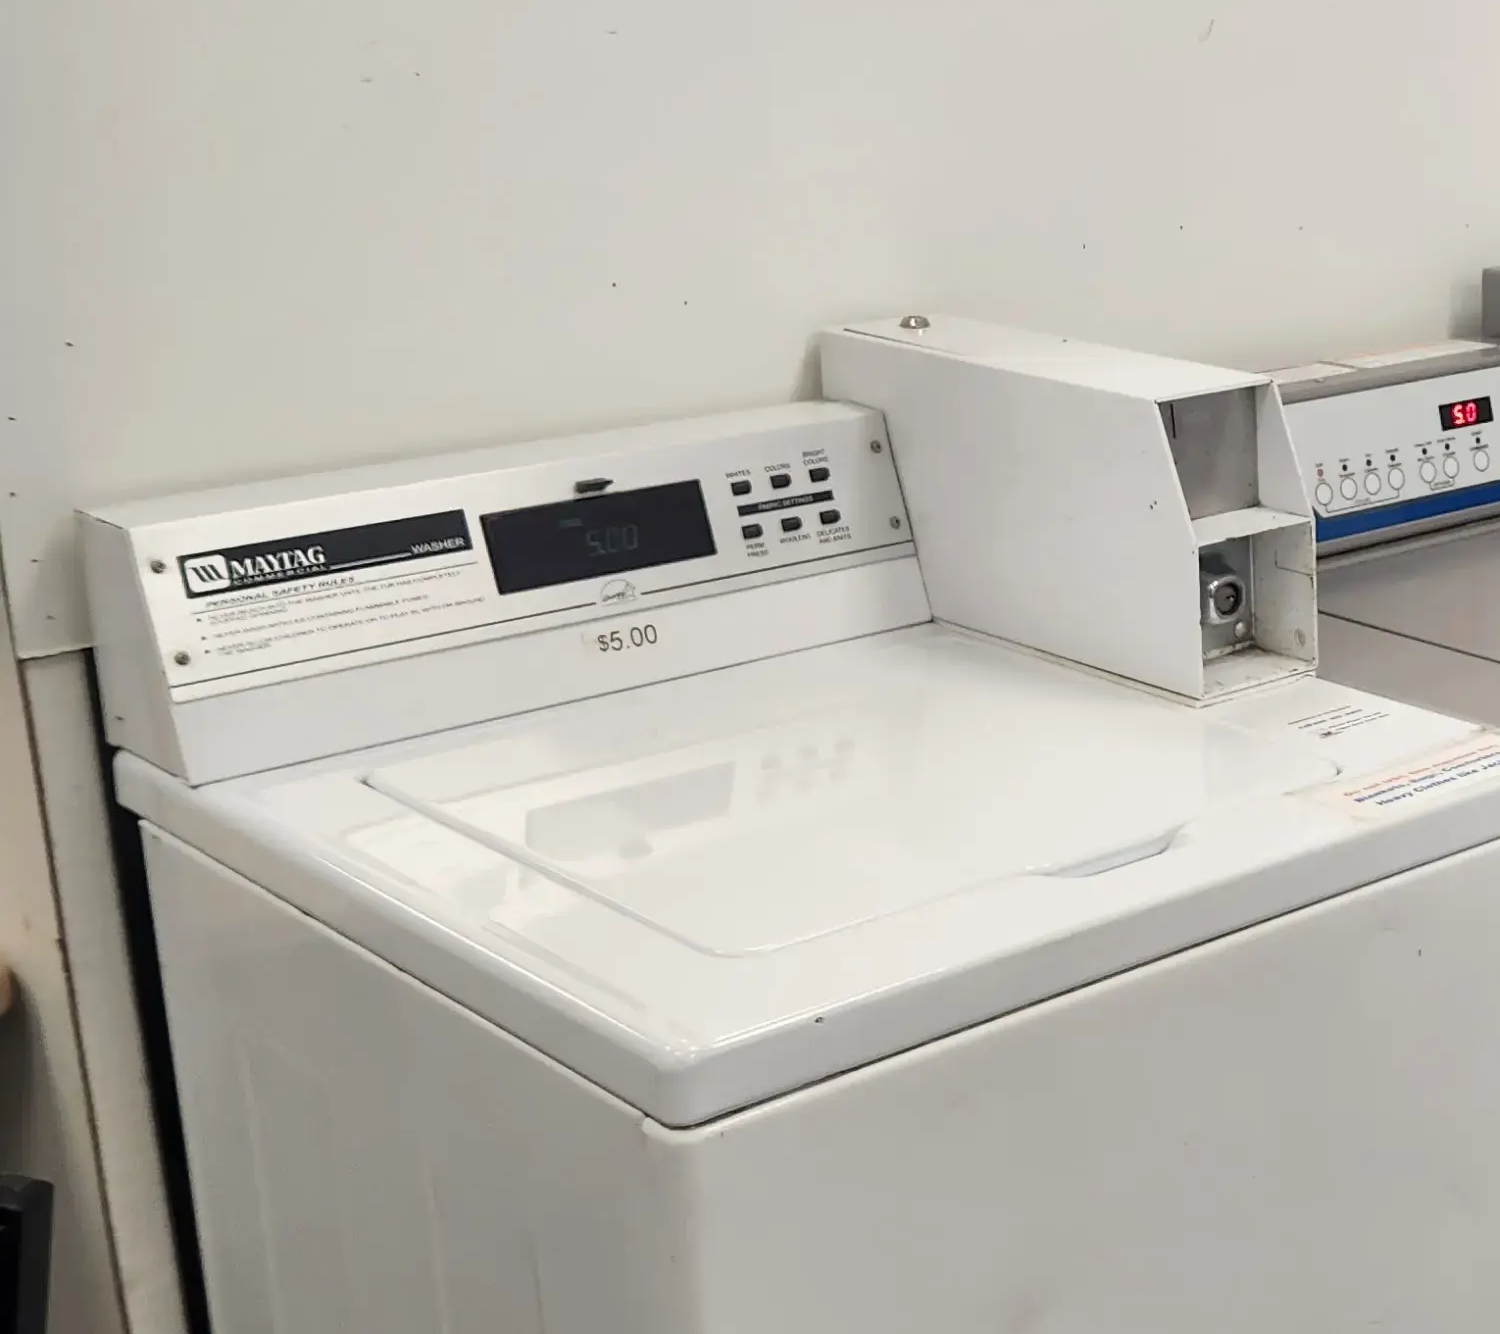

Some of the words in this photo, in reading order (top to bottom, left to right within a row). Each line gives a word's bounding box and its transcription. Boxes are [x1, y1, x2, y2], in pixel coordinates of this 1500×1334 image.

[764, 463, 790, 473] COLORS
[803, 456, 829, 466] COLORS
[725, 470, 751, 478] WHITES
[782, 495, 814, 506] SETTINGS
[411, 537, 465, 554] WASHER
[229, 545, 326, 579] MAYTAG
[232, 565, 328, 585] COMMERCIAL
[205, 591, 267, 607] PERSONAL
[272, 583, 315, 596] SAFETY
[318, 576, 355, 587] RULES
[597, 624, 658, 652] $5.00
[1413, 776, 1457, 792] Clothes
